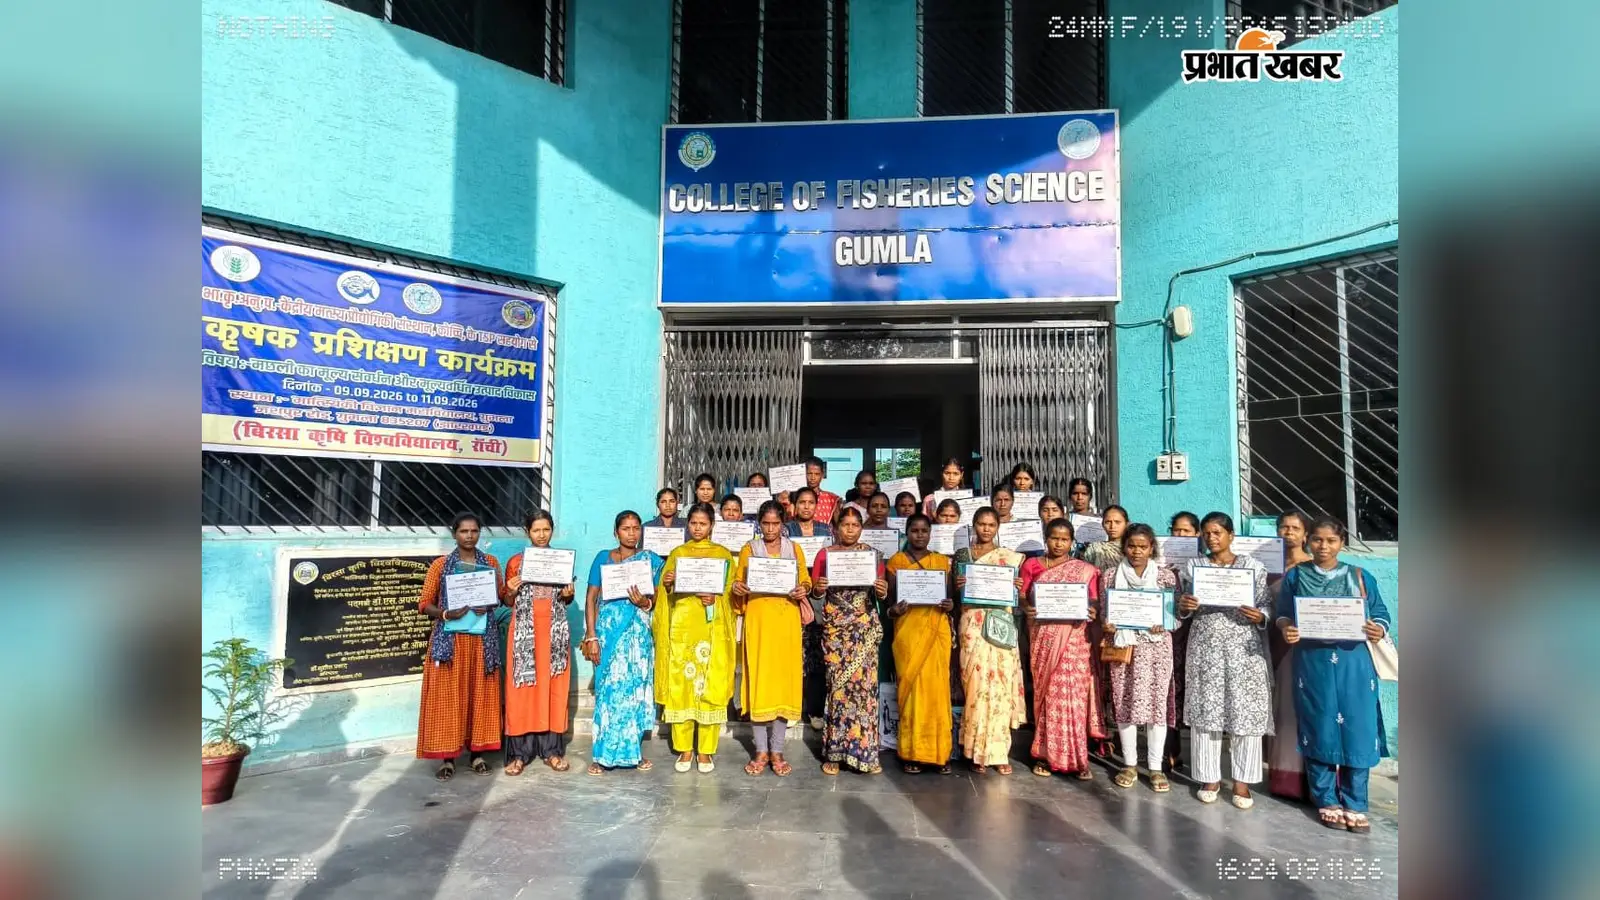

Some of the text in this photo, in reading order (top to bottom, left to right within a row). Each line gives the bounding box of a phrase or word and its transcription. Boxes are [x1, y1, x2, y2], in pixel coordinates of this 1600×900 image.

[669, 170, 1106, 213] COLLEGE OF FISHERIES SCIENCE
[835, 234, 932, 266] GUMLA
[202, 316, 536, 380] कृषक प्रशिक्षण कार्यक्रम
[466, 325, 477, 341] के
[202, 349, 239, 369] विषय
[297, 364, 316, 378] का
[317, 366, 349, 383] मूल्य
[504, 385, 536, 401] विकास
[228, 389, 275, 403] स्थान
[283, 379, 322, 393] दिनांक
[333, 385, 403, 401] 09.09.2026
[406, 392, 418, 403] to
[421, 393, 478, 409] 11.09.2026
[233, 420, 300, 441] (बिरसा
[307, 427, 348, 447] कृषि
[354, 427, 463, 453] विश्वविद्यालय,
